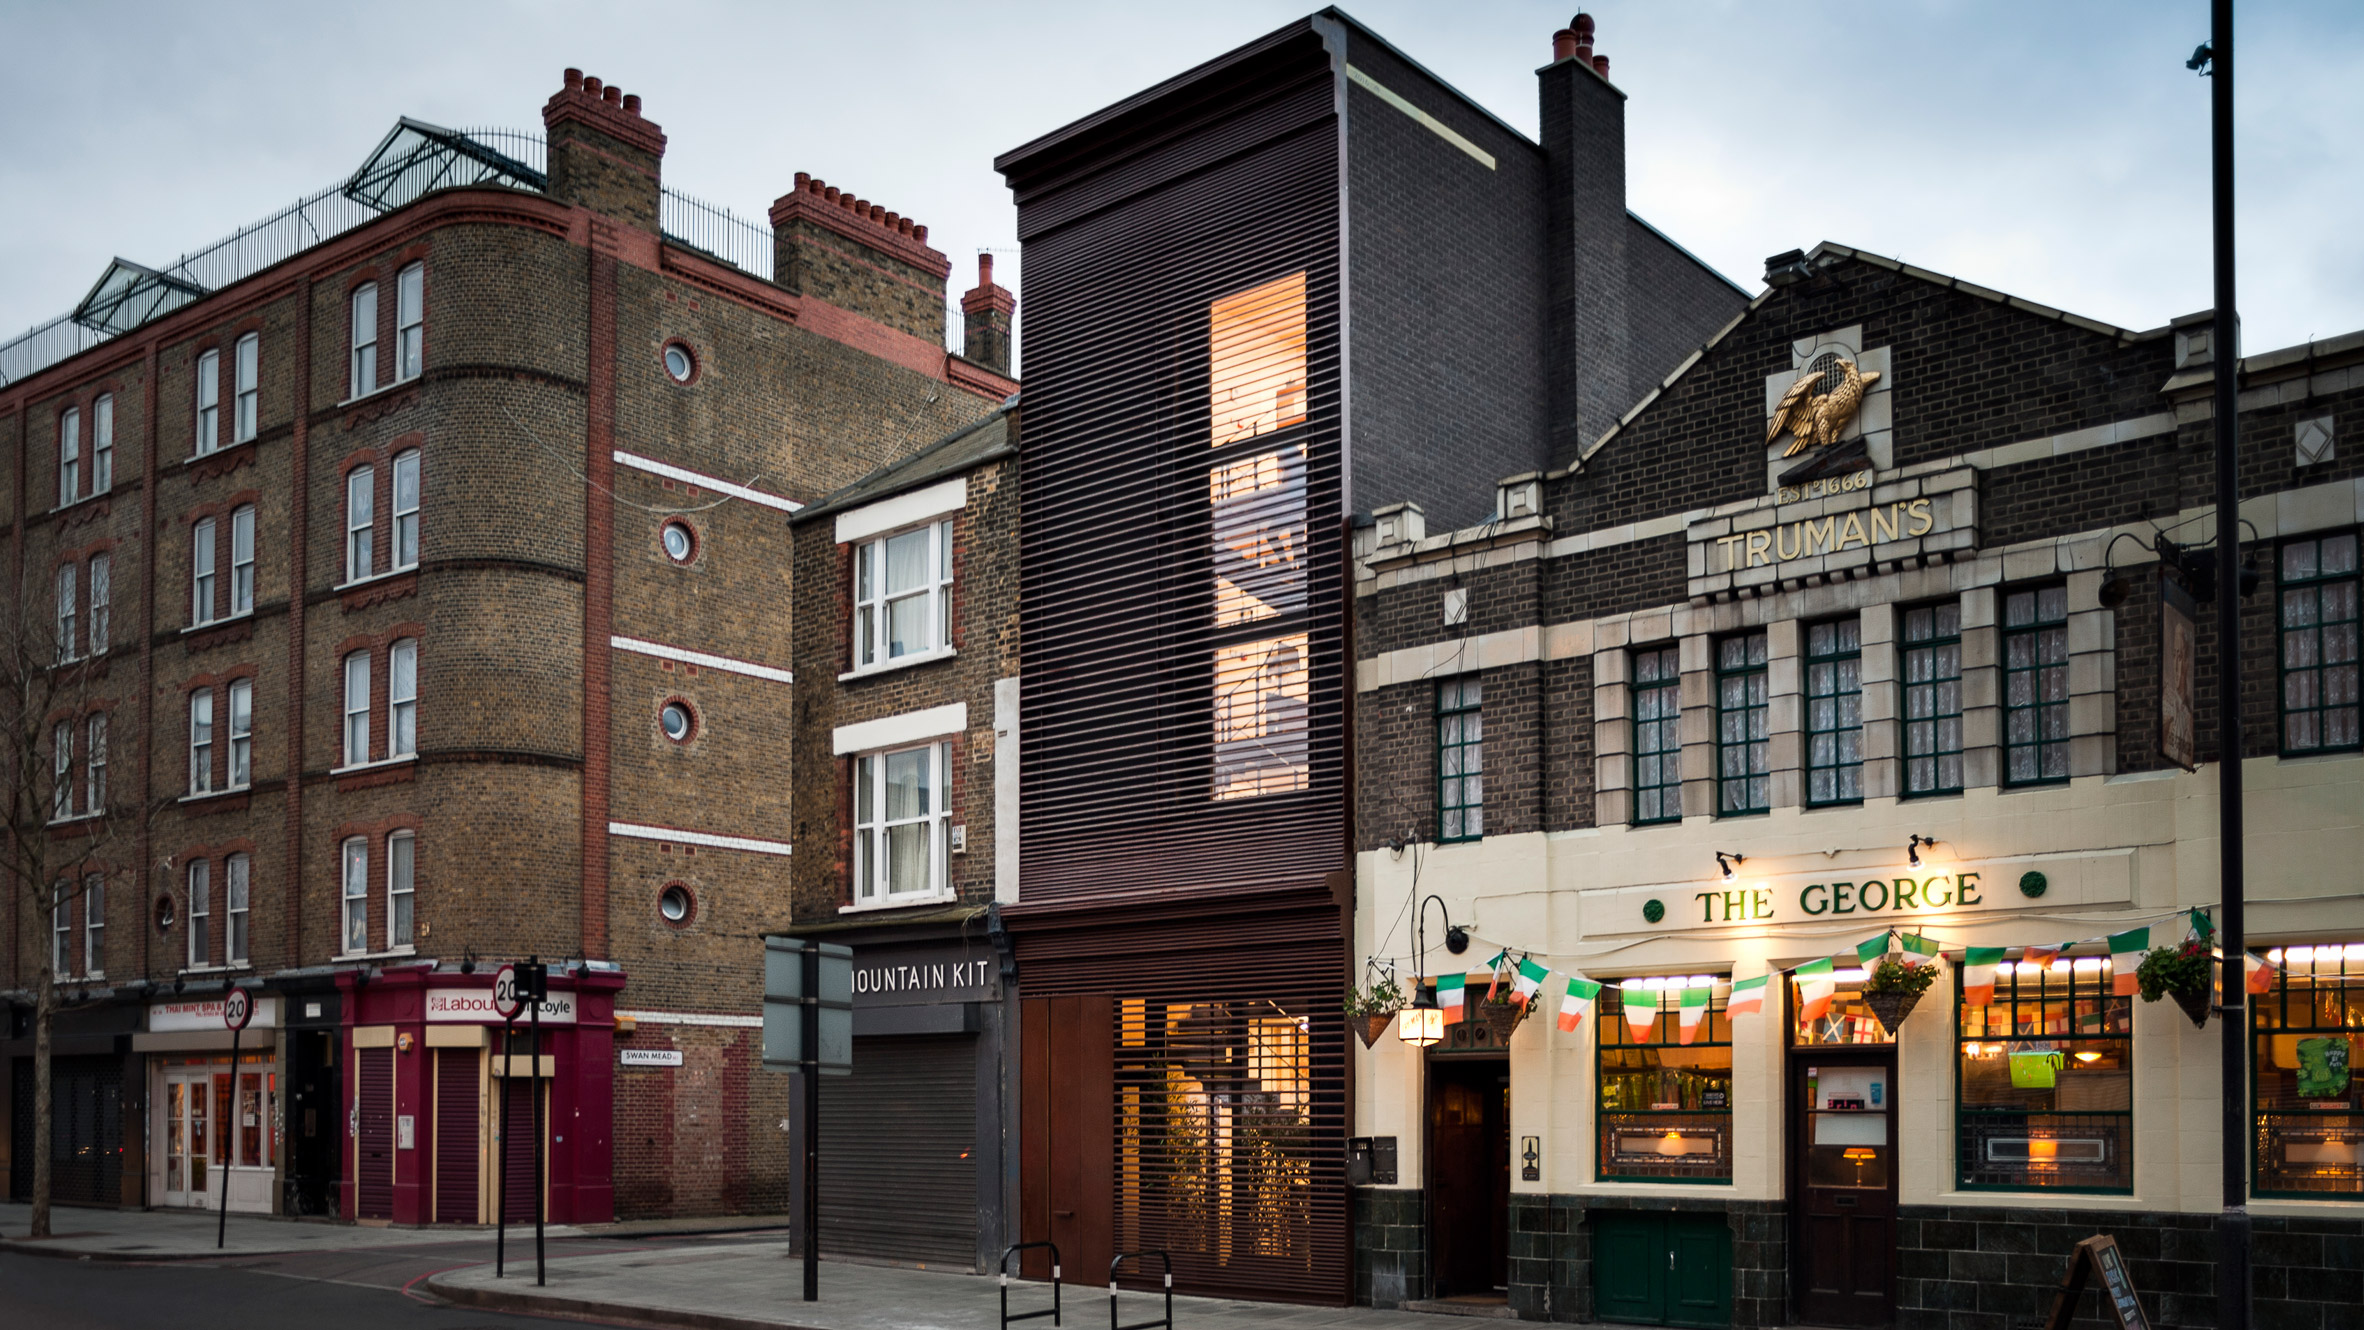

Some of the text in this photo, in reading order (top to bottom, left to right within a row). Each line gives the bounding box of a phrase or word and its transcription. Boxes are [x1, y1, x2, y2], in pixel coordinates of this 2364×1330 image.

[1822, 471, 1867, 497] 1666
[1717, 498, 1933, 571] TRUMAN'S
[1696, 872, 1982, 922] THE GEORGE
[851, 961, 988, 993] OUNTAIN KIT
[498, 980, 515, 1001] 20
[165, 1004, 181, 1014] THAI
[182, 1003, 200, 1013] MINT
[202, 1001, 215, 1011] SPA
[227, 1000, 244, 1018] 20
[443, 997, 498, 1011] Labou
[626, 1052, 649, 1060] SWAN
[651, 1052, 672, 1060] MEAD
